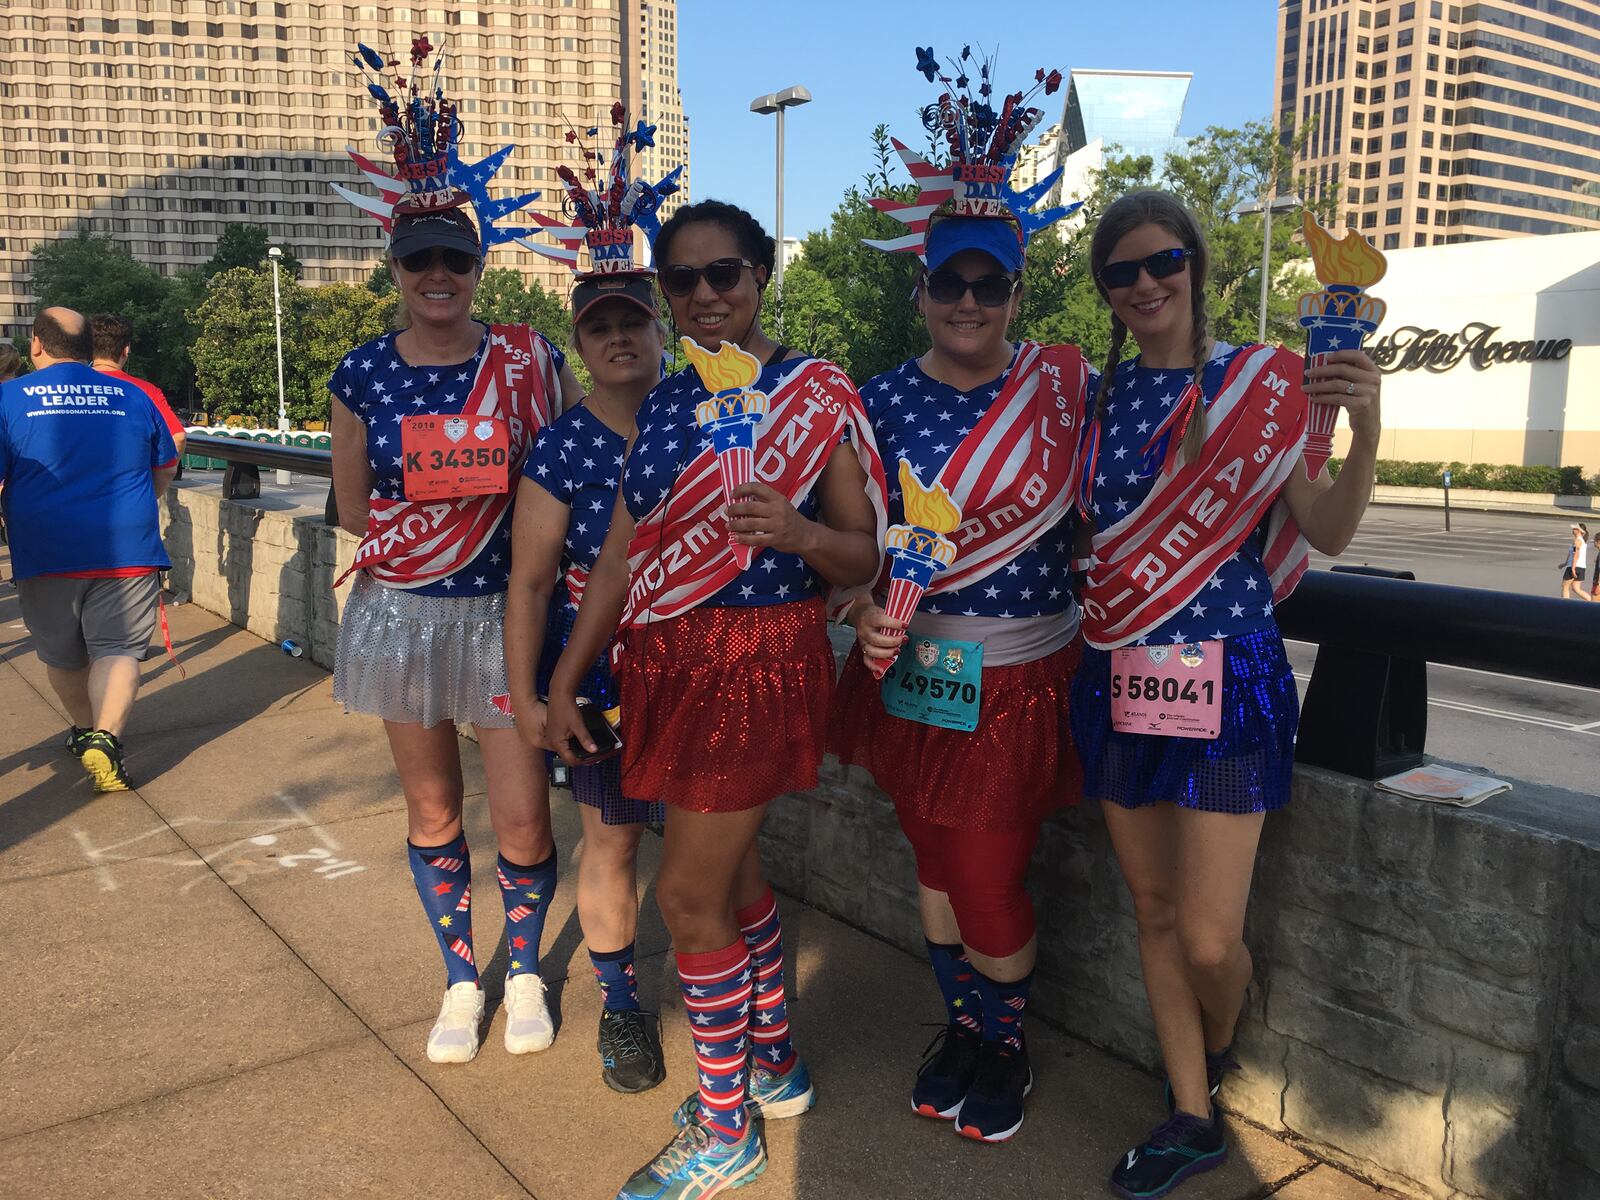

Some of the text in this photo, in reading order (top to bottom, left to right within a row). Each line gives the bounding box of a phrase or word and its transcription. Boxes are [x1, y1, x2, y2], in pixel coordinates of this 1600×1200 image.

[588, 229, 634, 249] BEST
[593, 244, 632, 261] DAY
[491, 333, 532, 366] MISS
[1424, 322, 1573, 374] Avenue
[23, 384, 125, 397] VOLUNTEER
[42, 396, 109, 407] LEADER
[804, 376, 842, 415] MISS
[1040, 361, 1072, 428] MISS
[26, 409, 126, 418] WWW.HANDSONATLANTA.ORG
[1253, 371, 1290, 464] MISS
[406, 447, 506, 473] K 34350
[900, 671, 977, 705] 49570
[1112, 674, 1214, 705] S 58041
